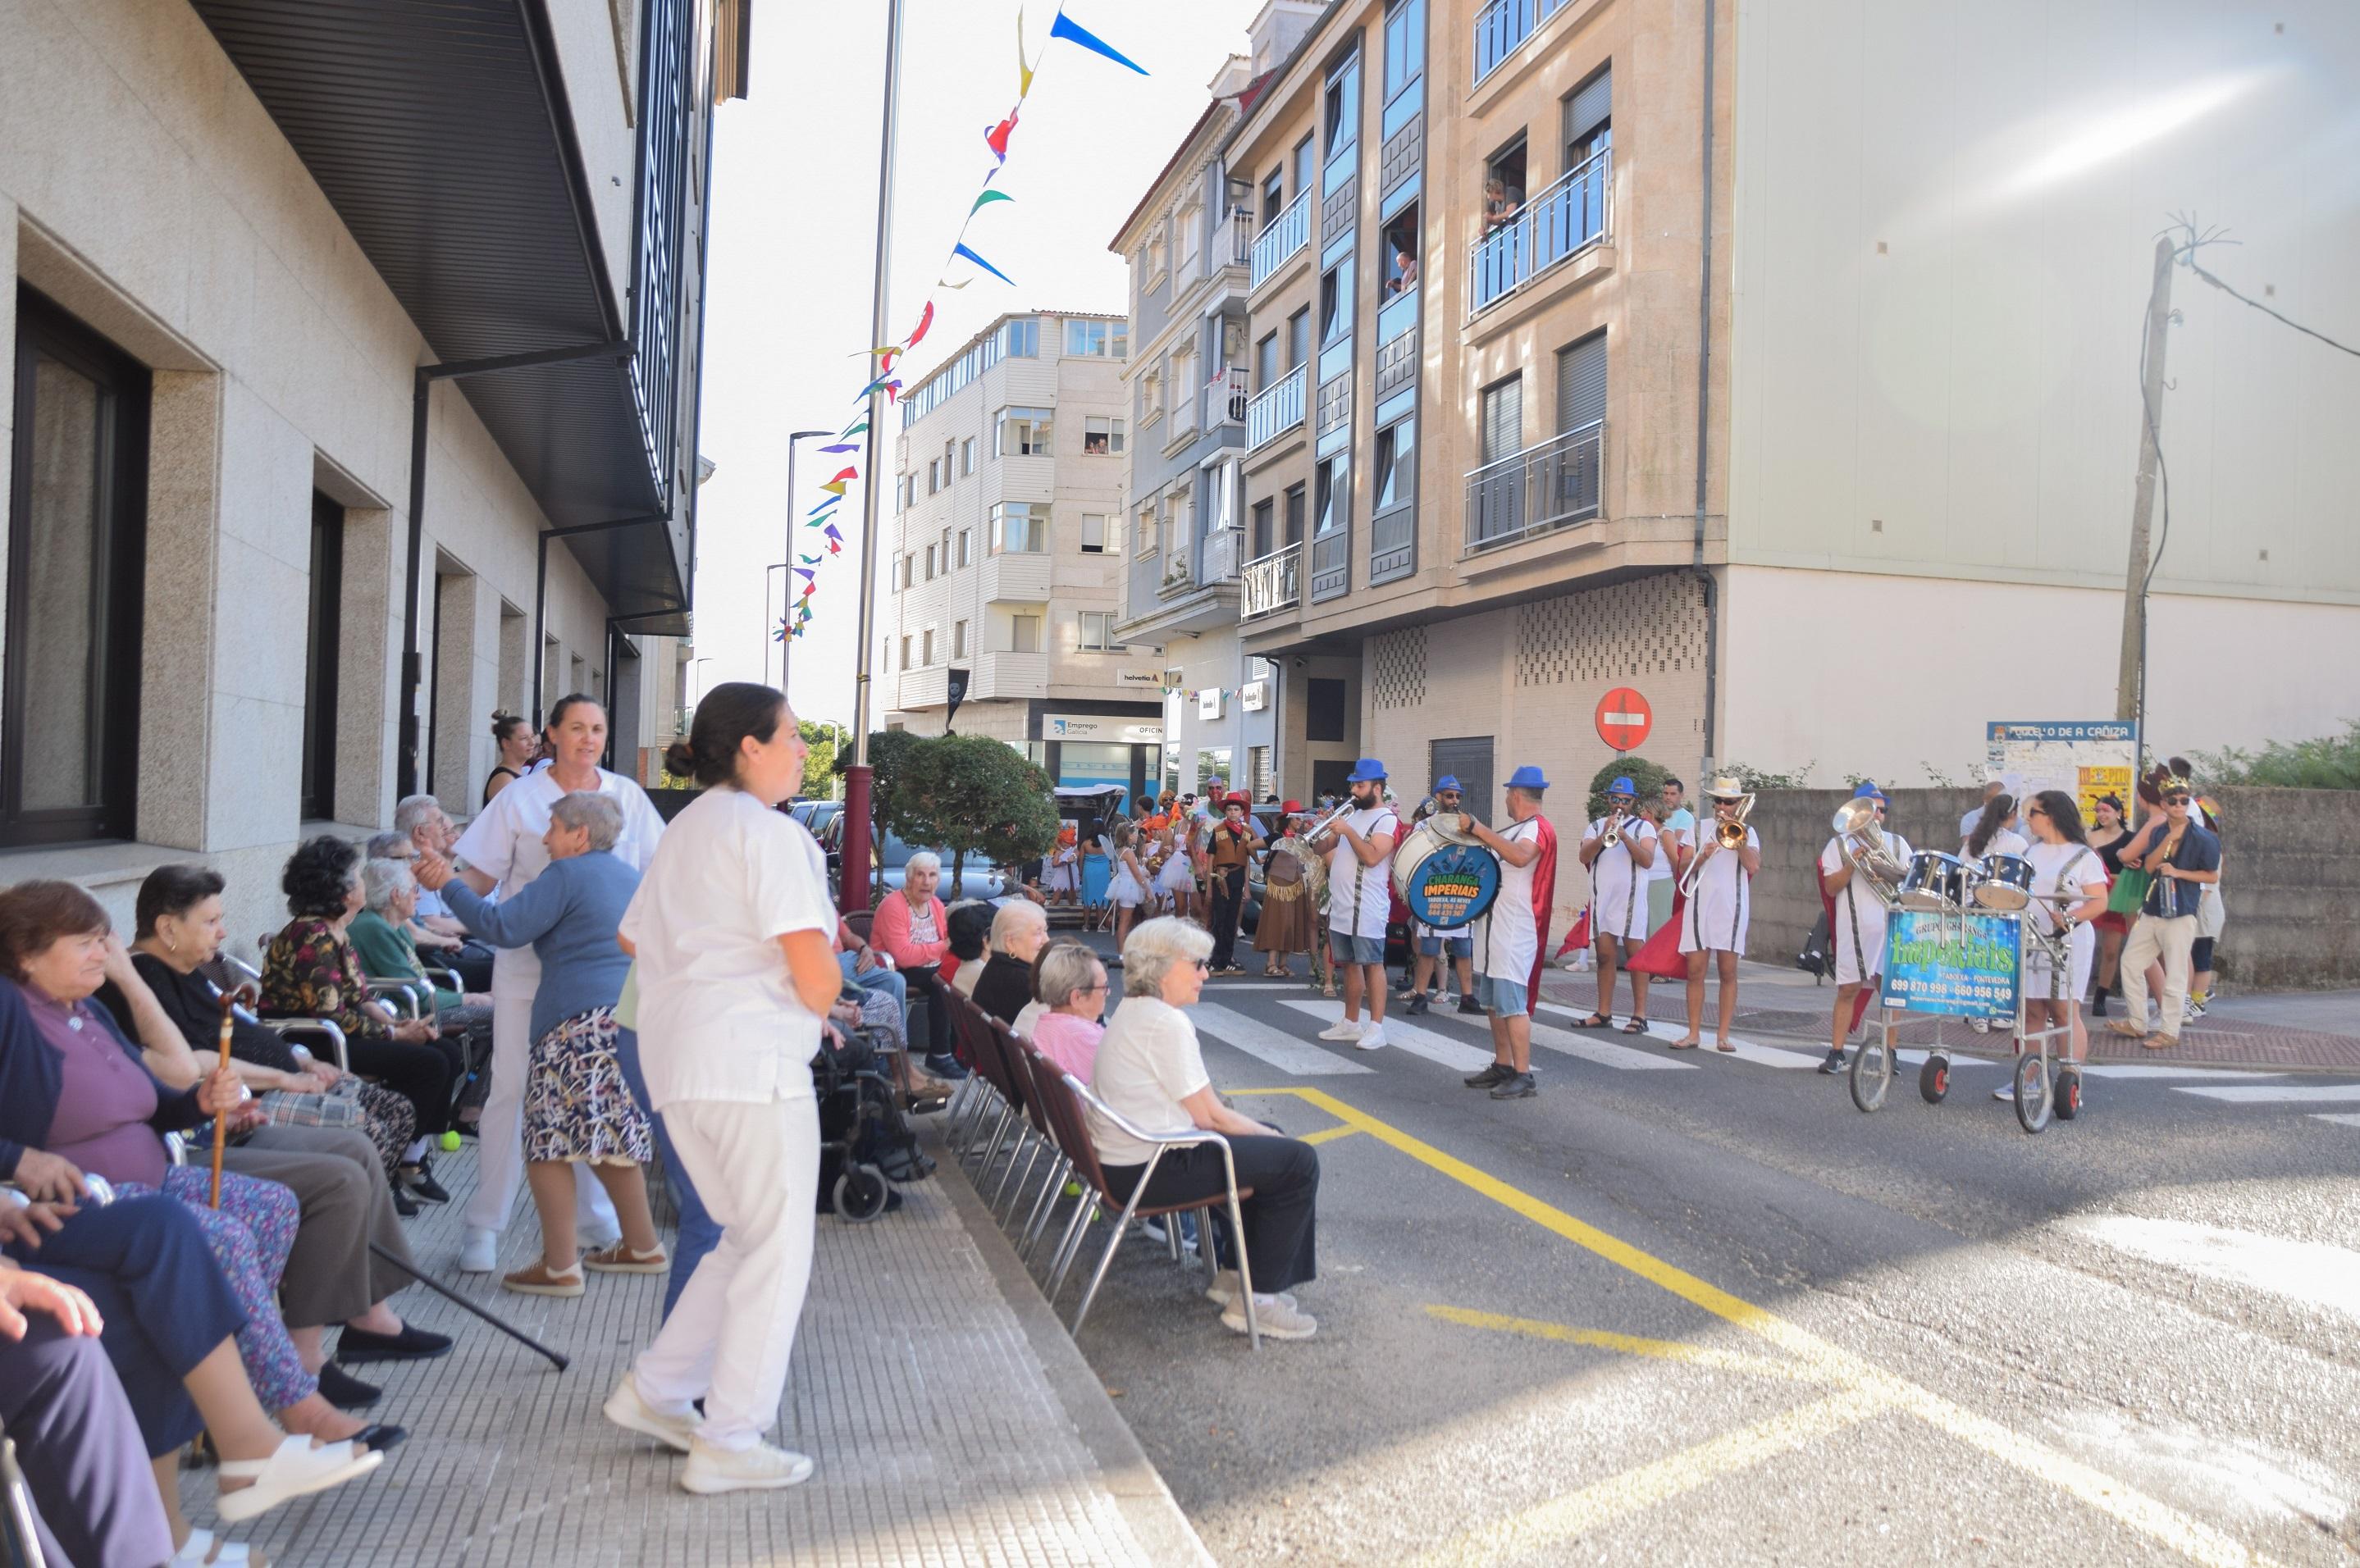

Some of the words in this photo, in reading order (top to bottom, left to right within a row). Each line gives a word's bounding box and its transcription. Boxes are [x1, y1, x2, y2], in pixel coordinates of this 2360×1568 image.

[1067, 722, 1098, 730] Emprego
[2058, 727, 2072, 736] DE
[2075, 727, 2084, 736] A
[2087, 725, 2129, 736] CAÑIZA
[1428, 874, 1480, 886] CHARANGA
[1424, 884, 1479, 898] IMPERIAIS
[1891, 978, 1908, 991] 699
[1910, 981, 1928, 992] 870
[1929, 982, 1947, 994] 998
[1954, 985, 1972, 996] 660
[1974, 987, 1992, 998] 956
[1993, 987, 2012, 1001] 549
